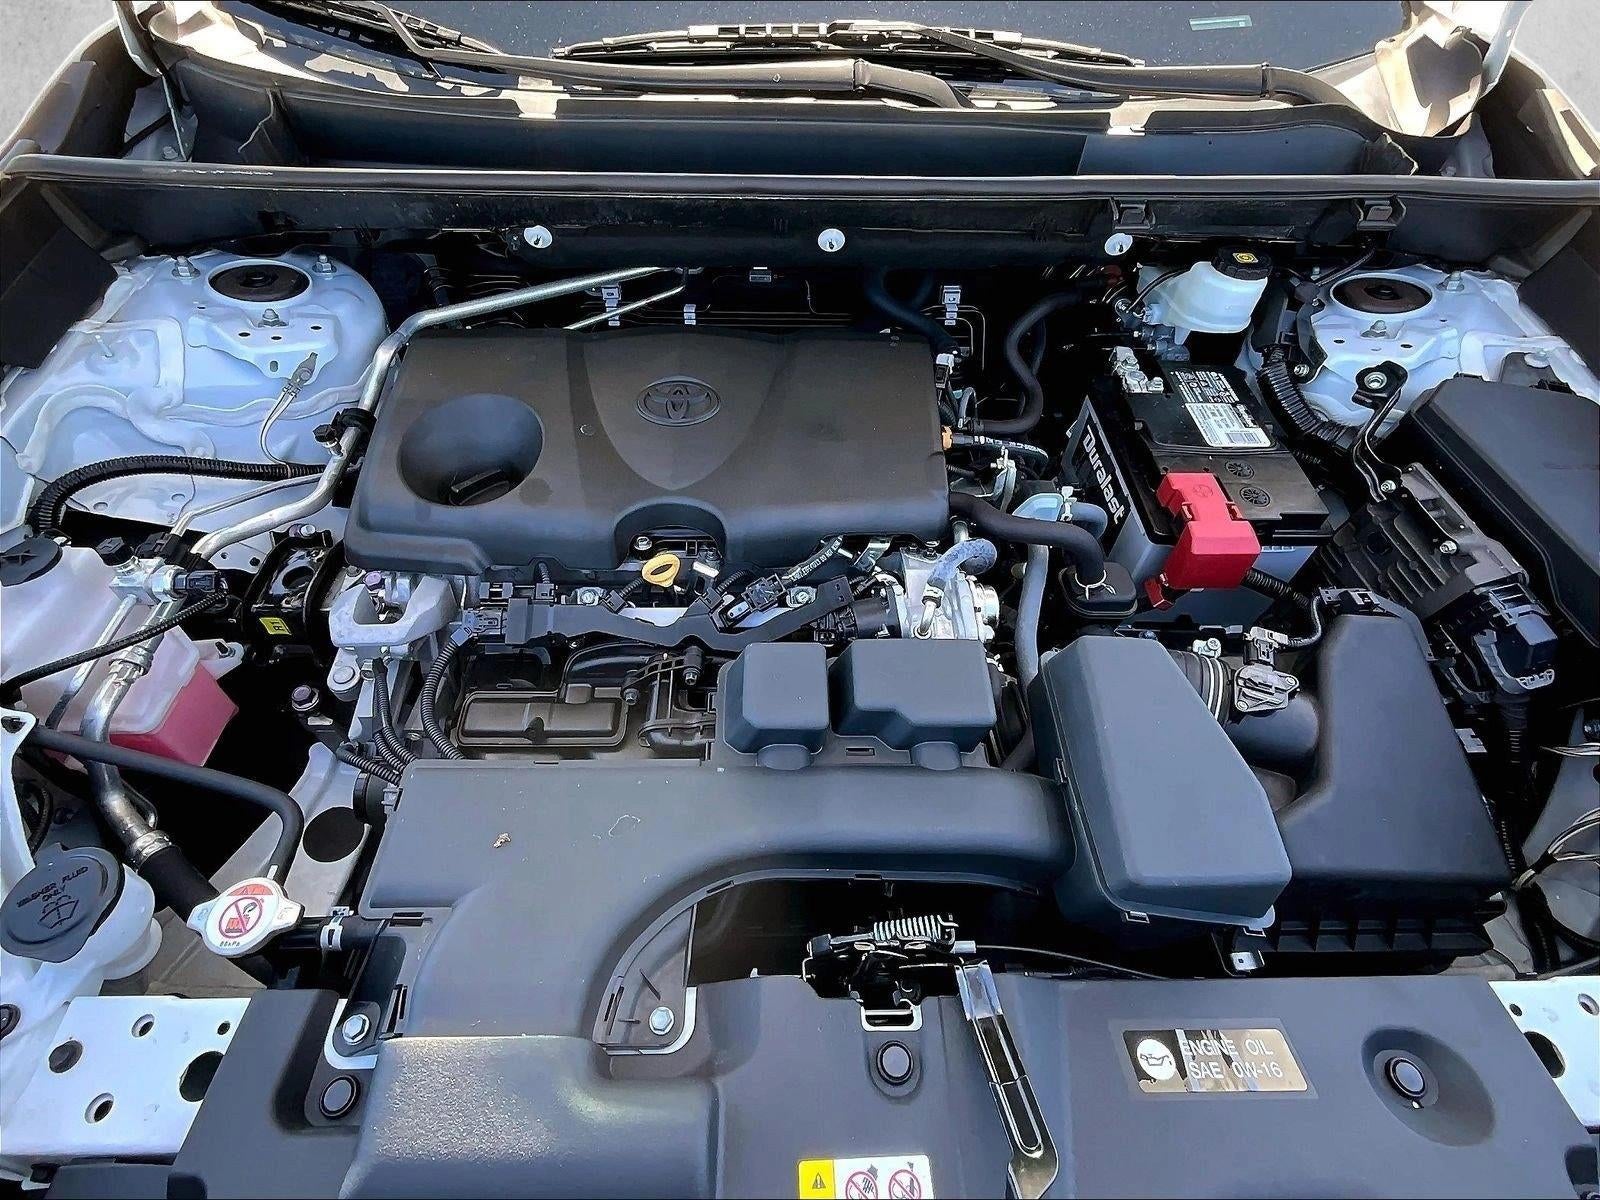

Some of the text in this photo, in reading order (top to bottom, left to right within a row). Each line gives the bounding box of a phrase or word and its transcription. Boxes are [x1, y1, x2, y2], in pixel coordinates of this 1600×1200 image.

[1083, 425, 1125, 525] Duralast
[1182, 1038, 1274, 1056] ENGINE OIL
[1187, 1061, 1284, 1079] SAE 0W-16
